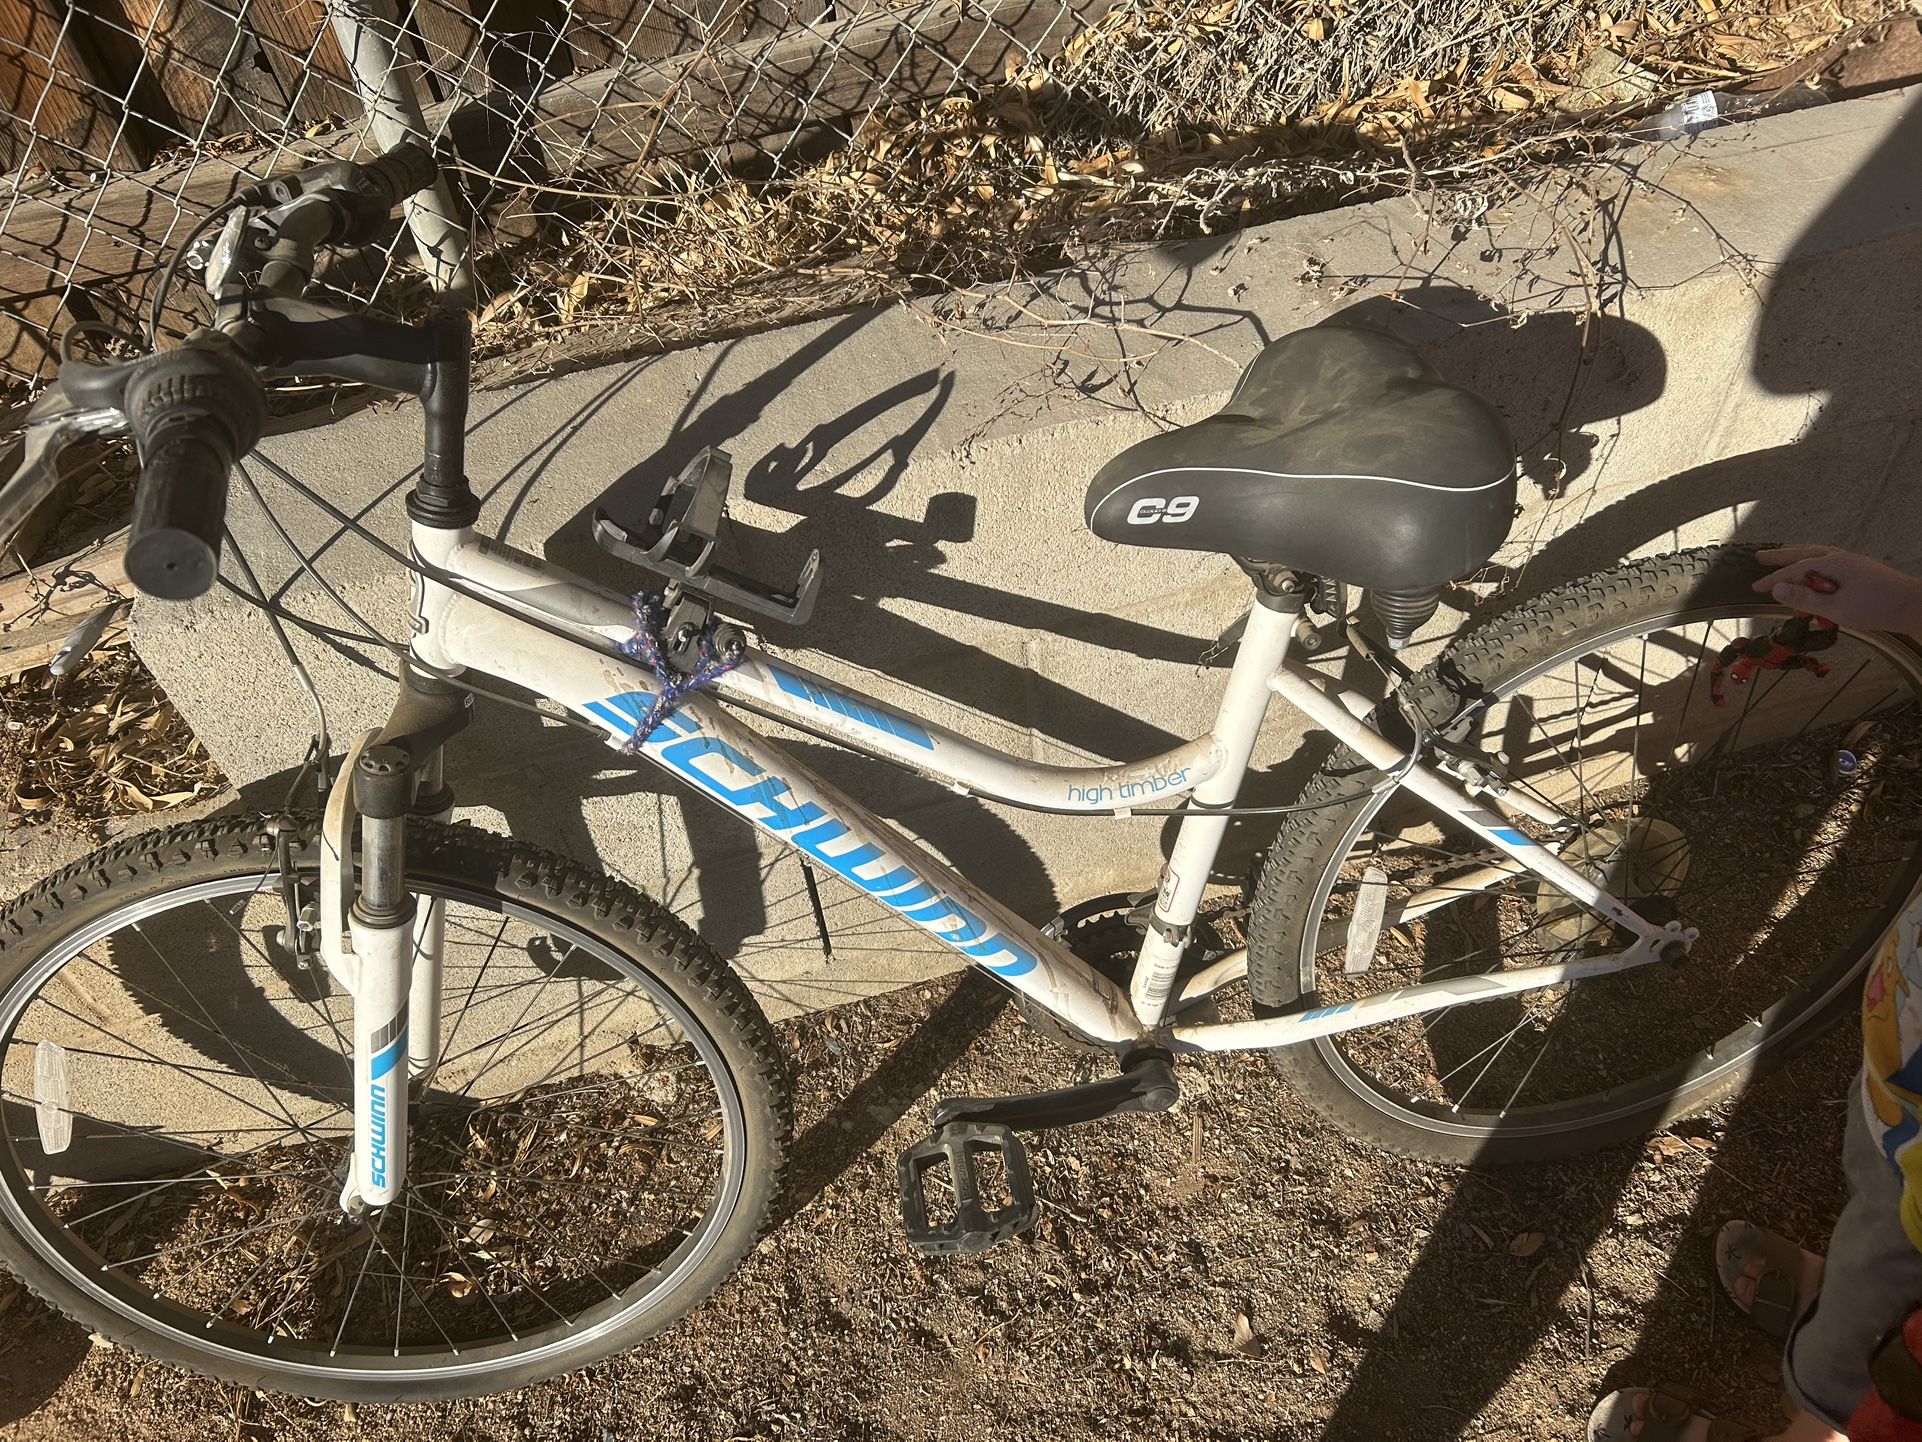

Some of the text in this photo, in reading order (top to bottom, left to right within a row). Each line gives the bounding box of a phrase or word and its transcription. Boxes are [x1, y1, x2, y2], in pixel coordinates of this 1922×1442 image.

[1127, 496, 1200, 525] C9
[1068, 767, 1191, 805] high timber
[582, 691, 1038, 977] SCHWINN
[370, 1084, 386, 1189] SCHWINN
